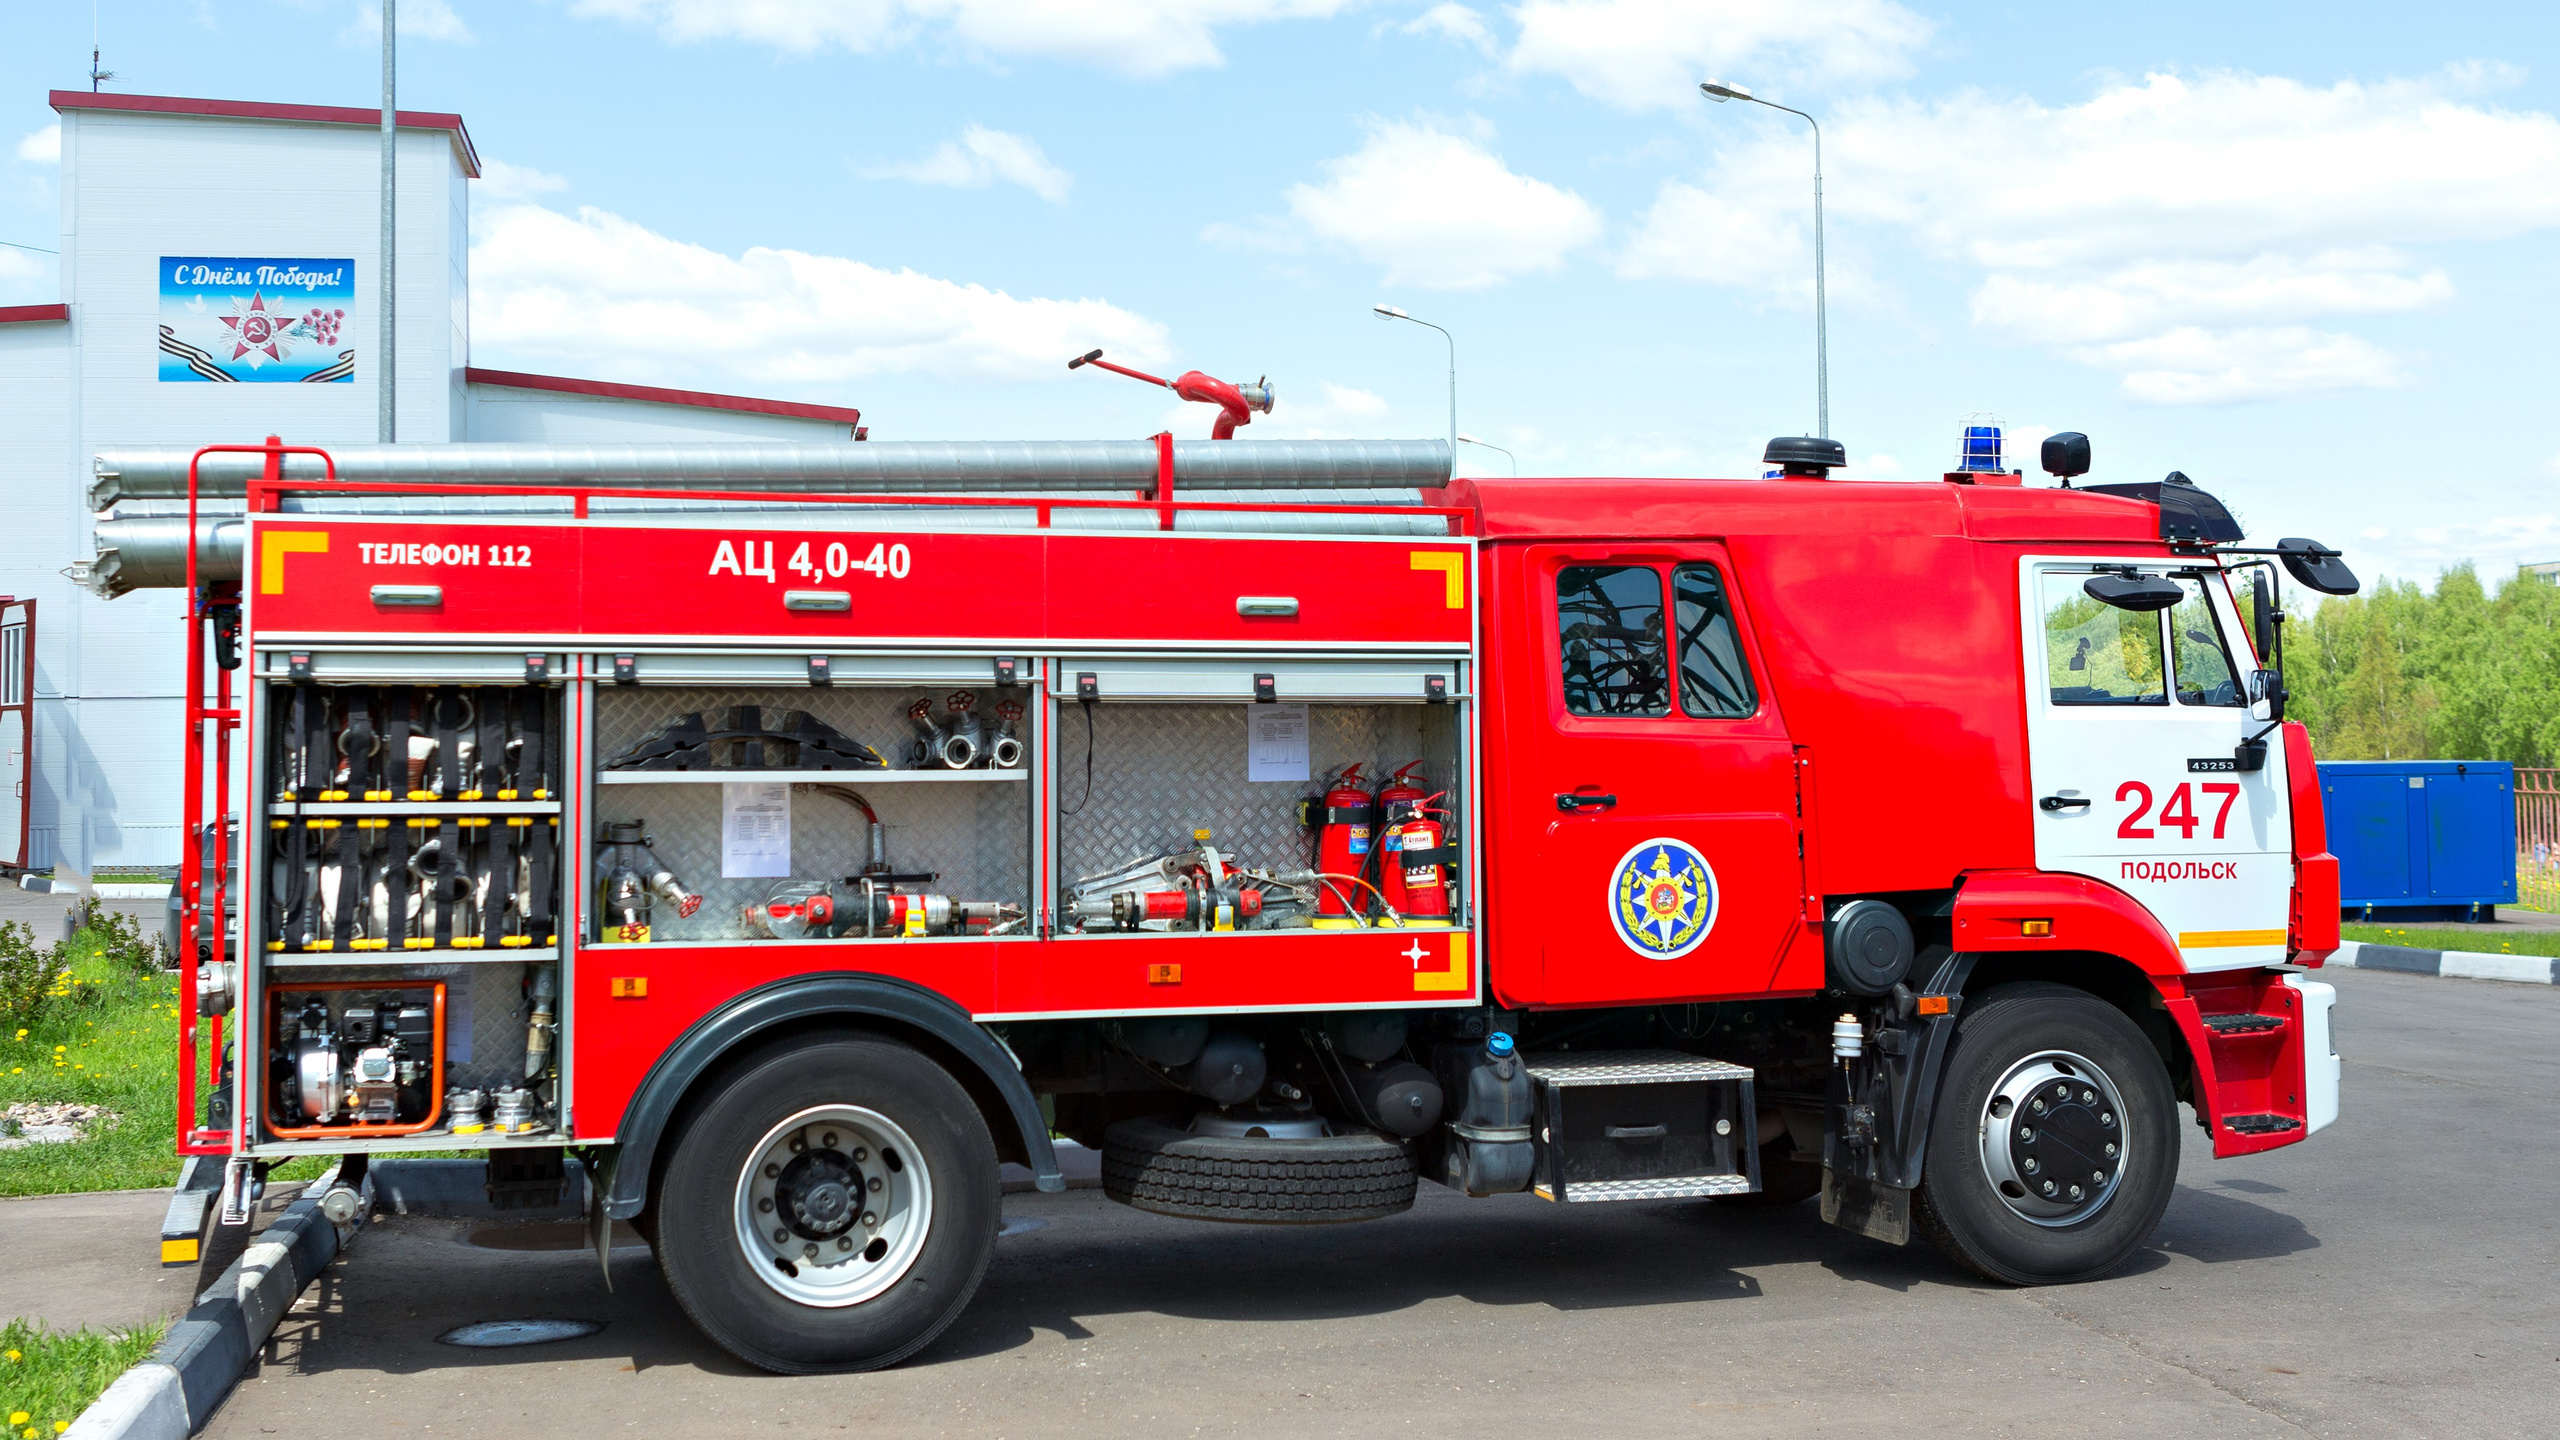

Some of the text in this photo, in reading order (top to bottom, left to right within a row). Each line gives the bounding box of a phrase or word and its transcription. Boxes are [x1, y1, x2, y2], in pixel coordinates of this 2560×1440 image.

[174, 265, 343, 292] С Днём Победы!
[358, 542, 532, 567] ТЕЛЕФОН 112
[708, 539, 911, 584] АЦ 4,0-40
[2191, 761, 2236, 770] 43253
[2114, 780, 2240, 840] 247
[2121, 861, 2238, 883] ПОДОЛЬСК
